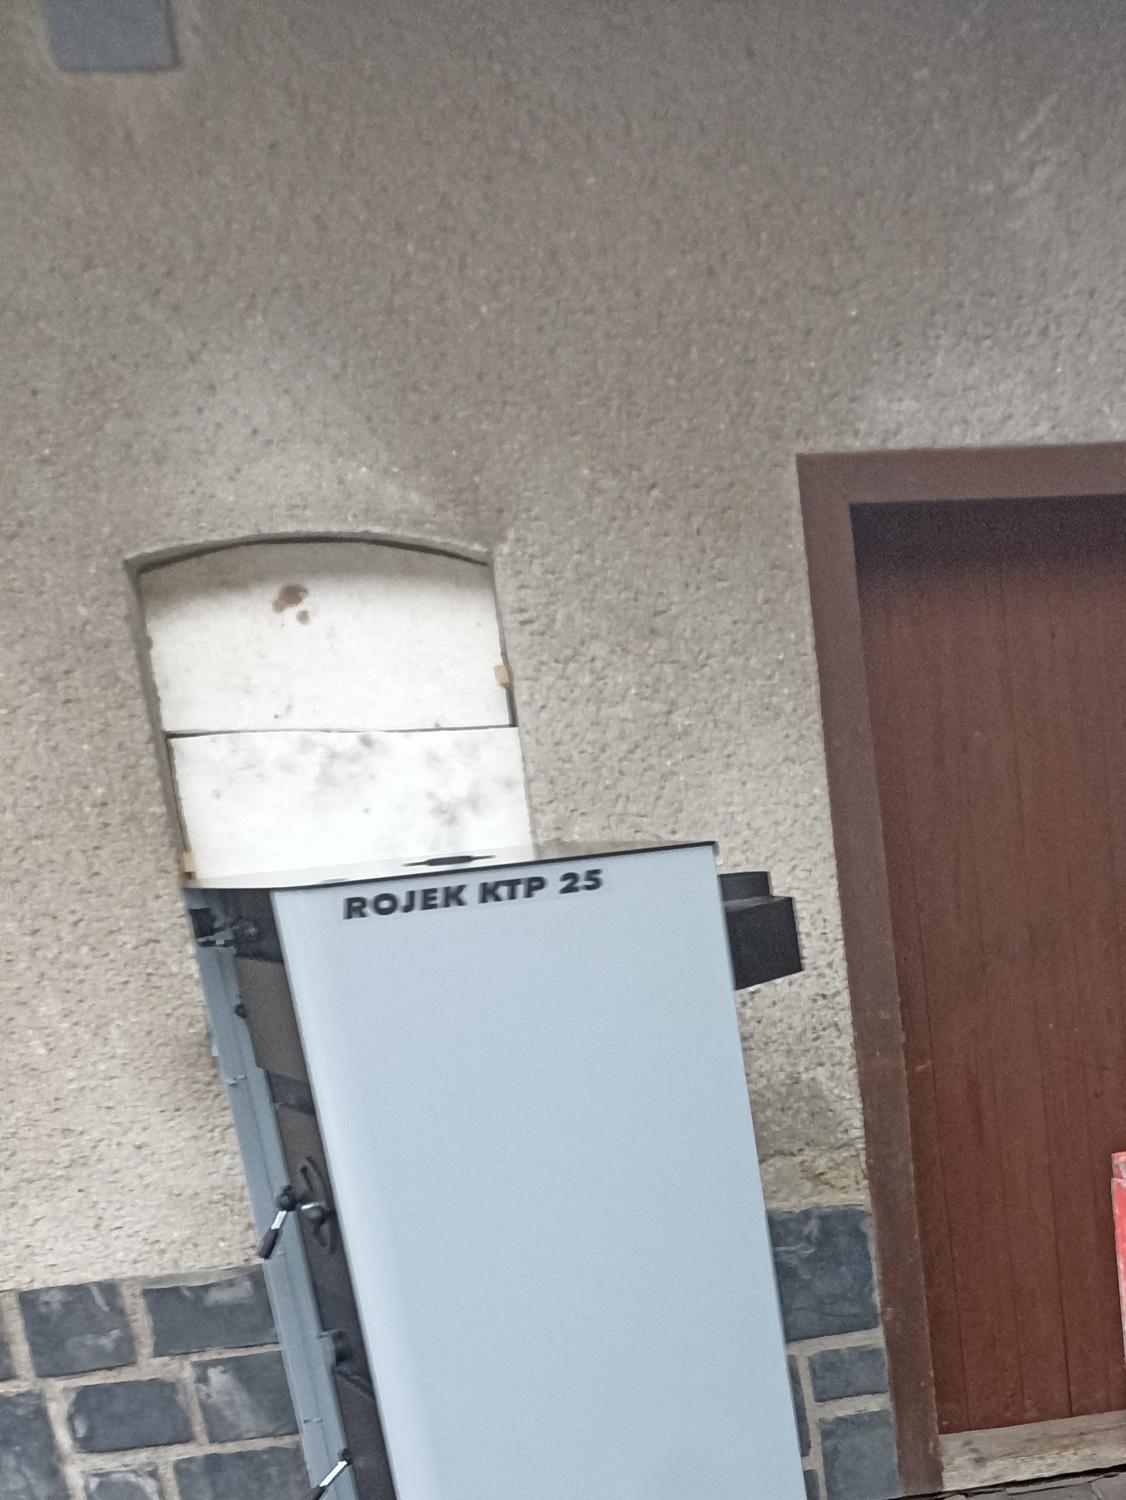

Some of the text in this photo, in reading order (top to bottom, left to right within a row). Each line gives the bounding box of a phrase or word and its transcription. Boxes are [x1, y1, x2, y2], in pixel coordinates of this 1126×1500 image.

[343, 868, 603, 920] ROJEK KTP 25
